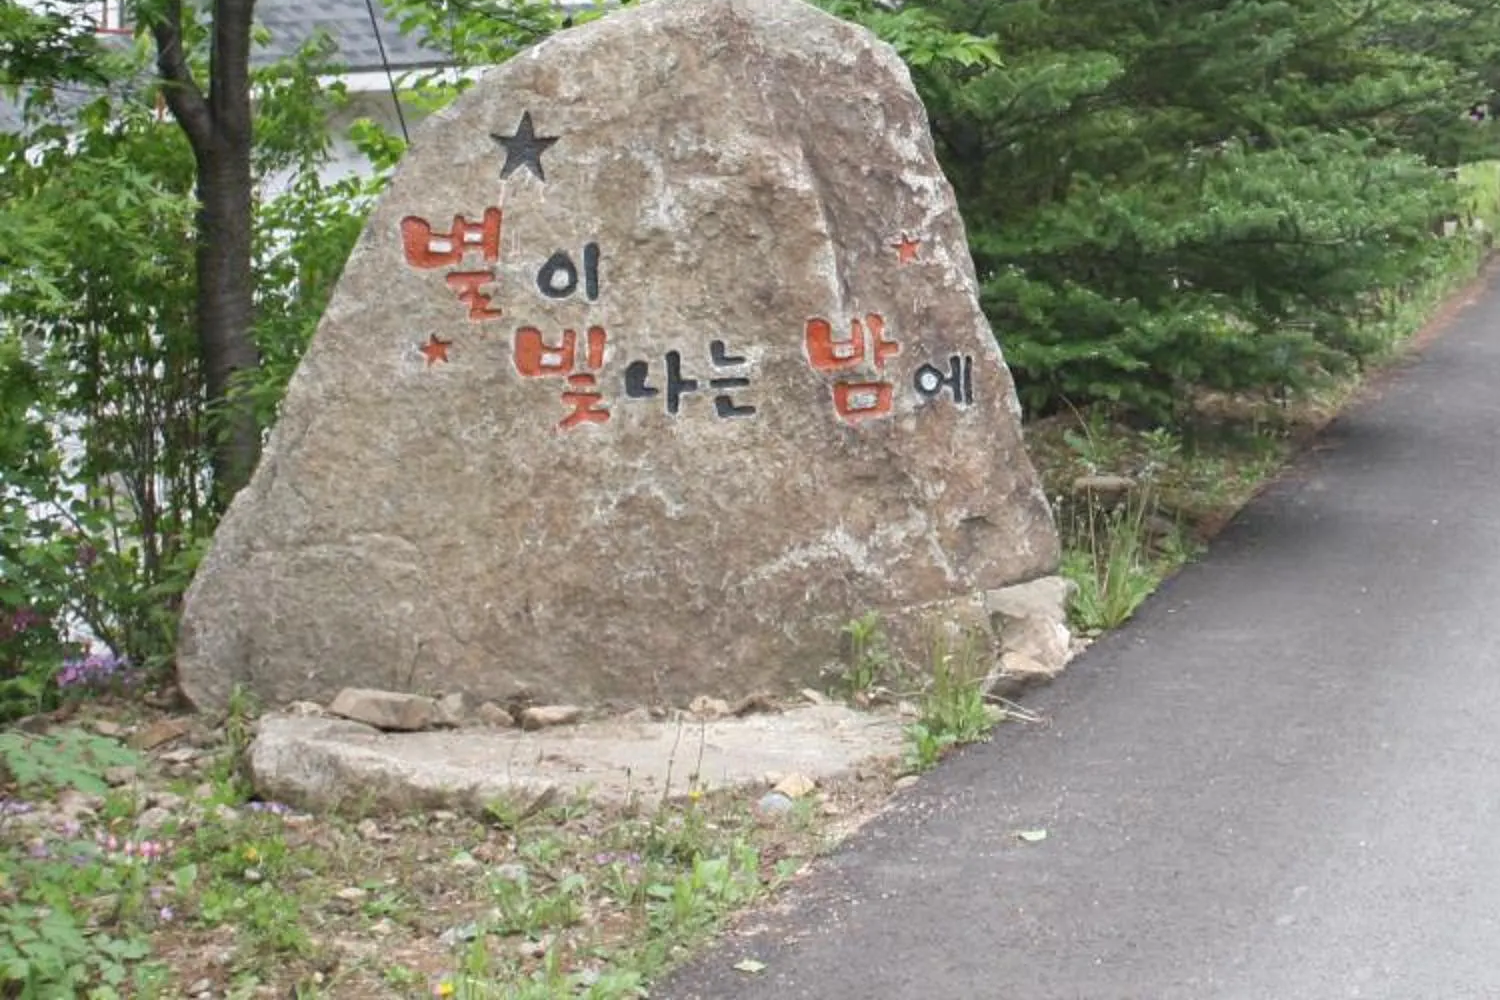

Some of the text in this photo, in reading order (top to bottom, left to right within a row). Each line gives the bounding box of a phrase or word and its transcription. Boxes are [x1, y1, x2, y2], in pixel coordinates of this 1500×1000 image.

[400, 206, 600, 321] 별이
[515, 312, 973, 431] 빛나는 밤에
